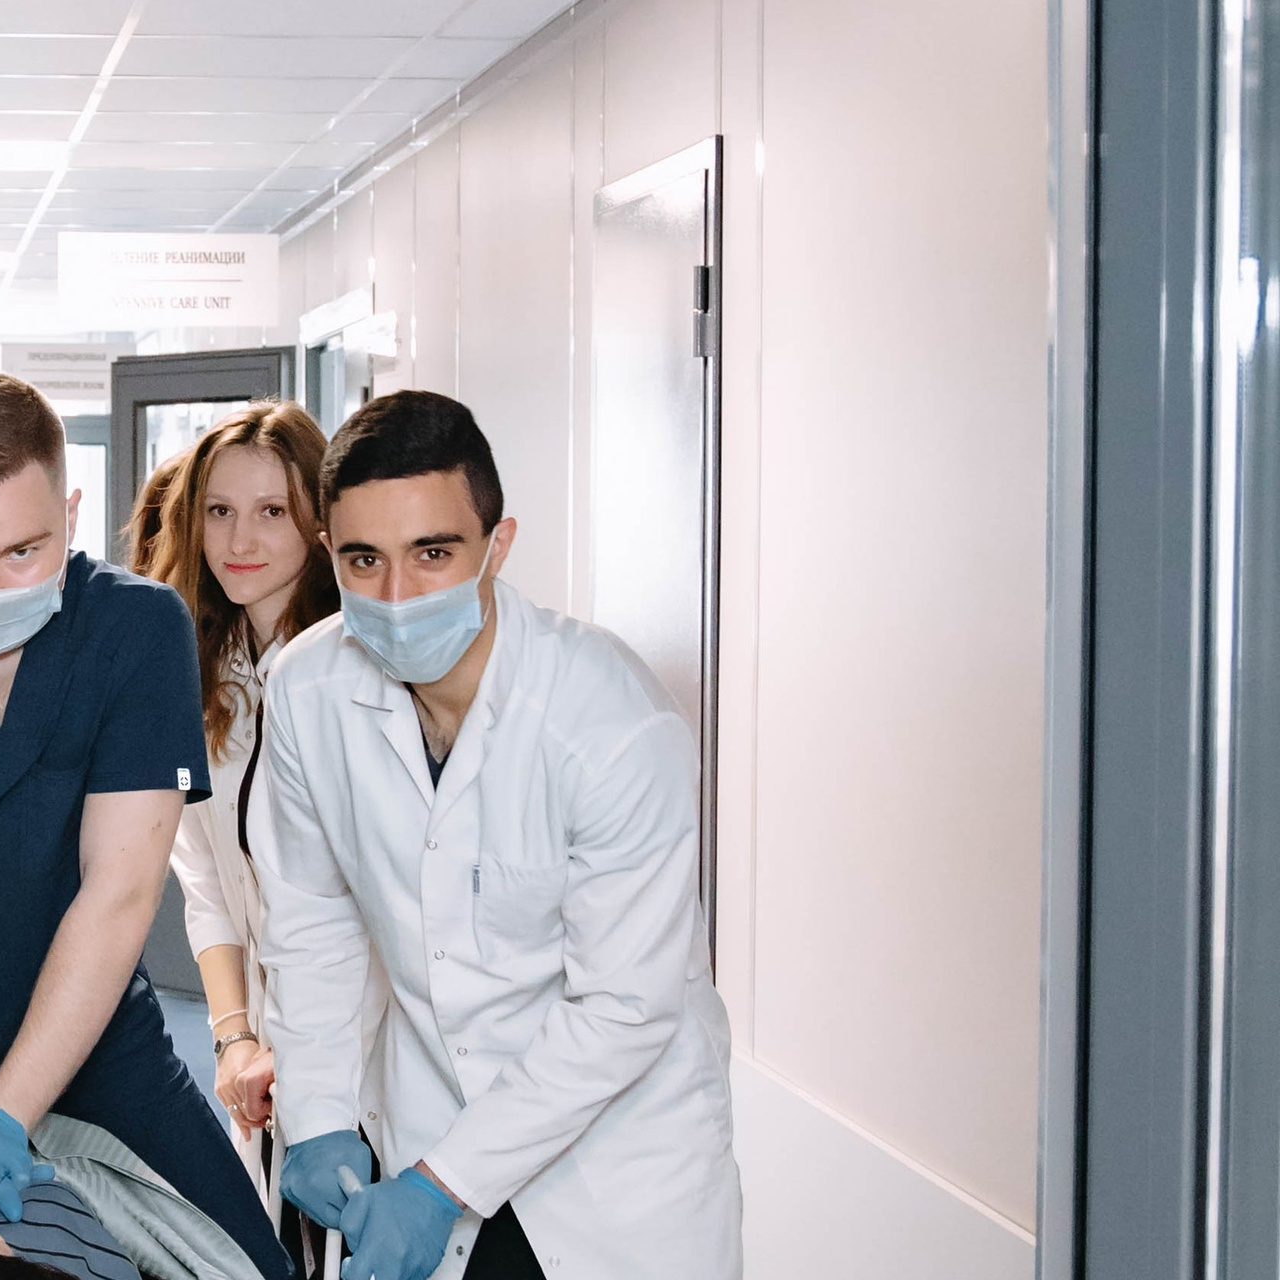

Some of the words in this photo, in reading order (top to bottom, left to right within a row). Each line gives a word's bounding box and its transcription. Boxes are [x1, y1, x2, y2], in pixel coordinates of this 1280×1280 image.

[165, 251, 246, 266] РЕАНИМАЦИИ
[170, 296, 199, 309] CARE
[204, 296, 231, 309] UNIT
